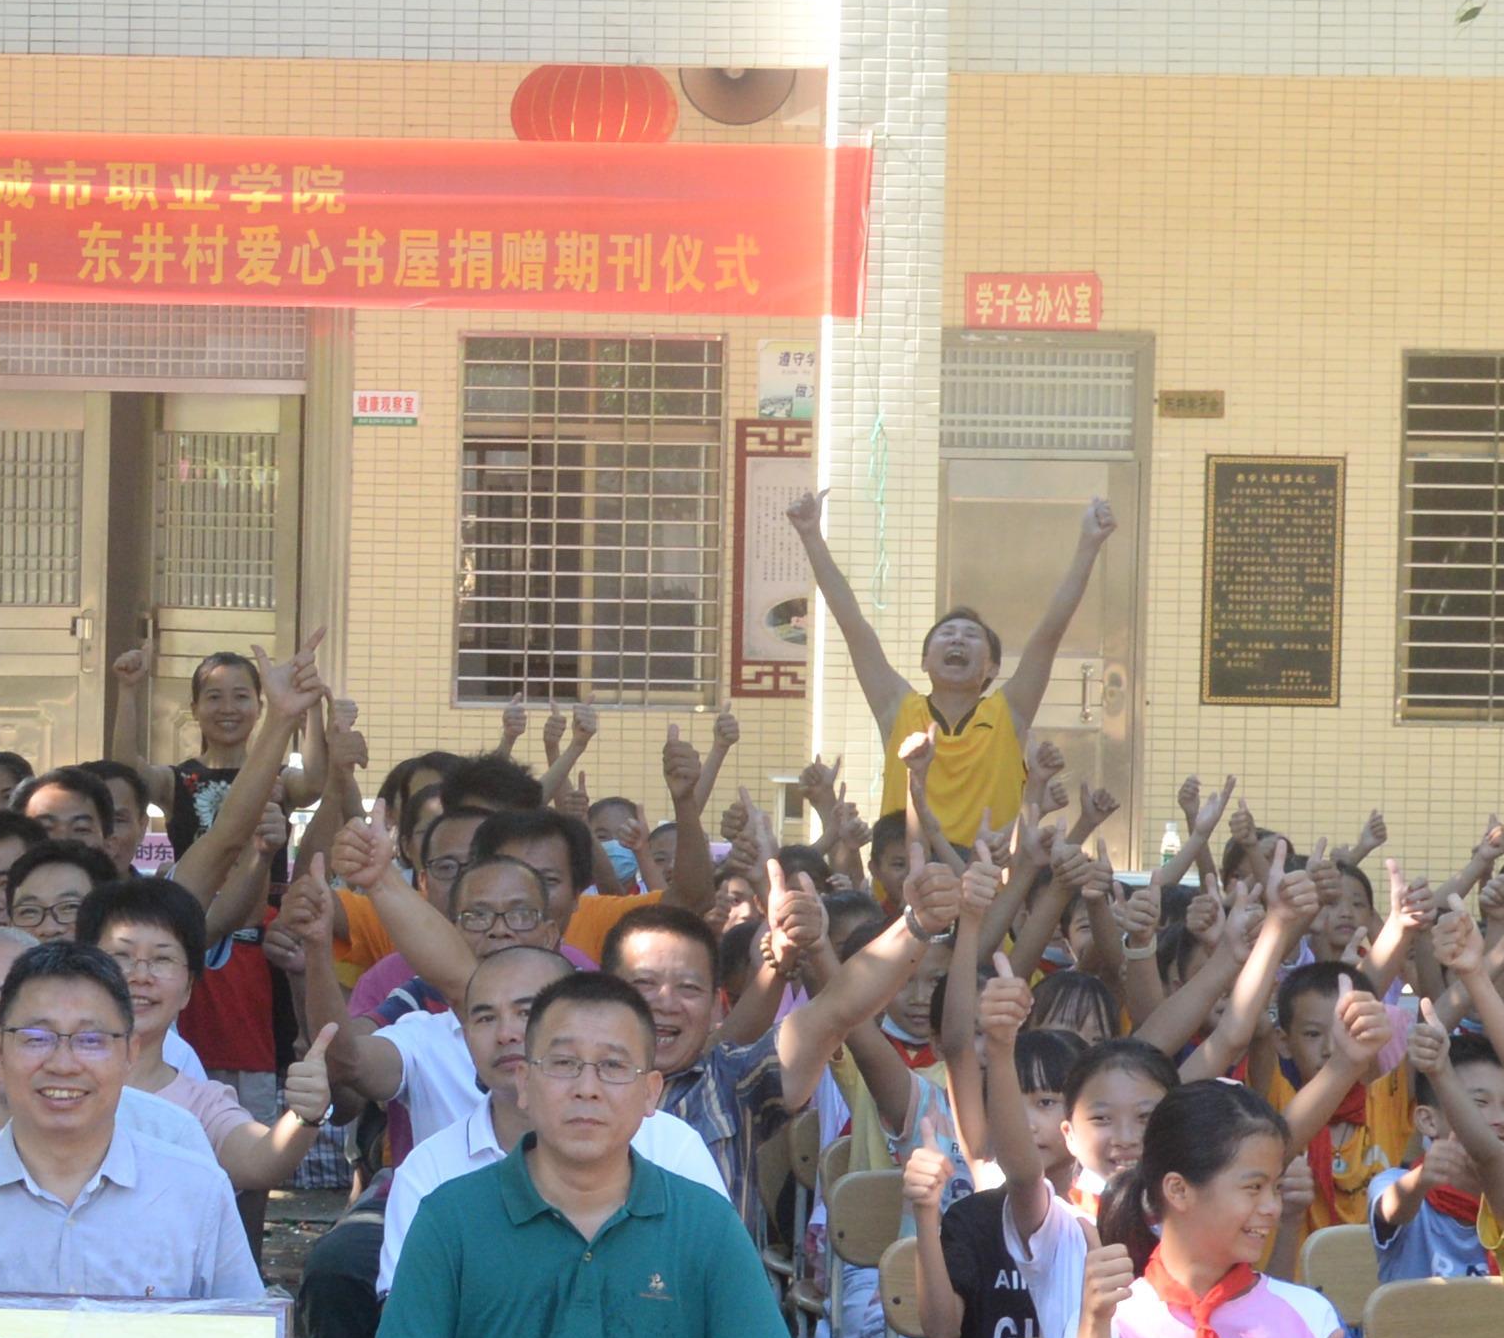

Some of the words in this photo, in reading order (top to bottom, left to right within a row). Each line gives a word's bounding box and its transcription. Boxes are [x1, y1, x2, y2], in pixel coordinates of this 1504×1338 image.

[975, 281, 1093, 325] 学子会办公室
[357, 395, 415, 413] 健康观察室
